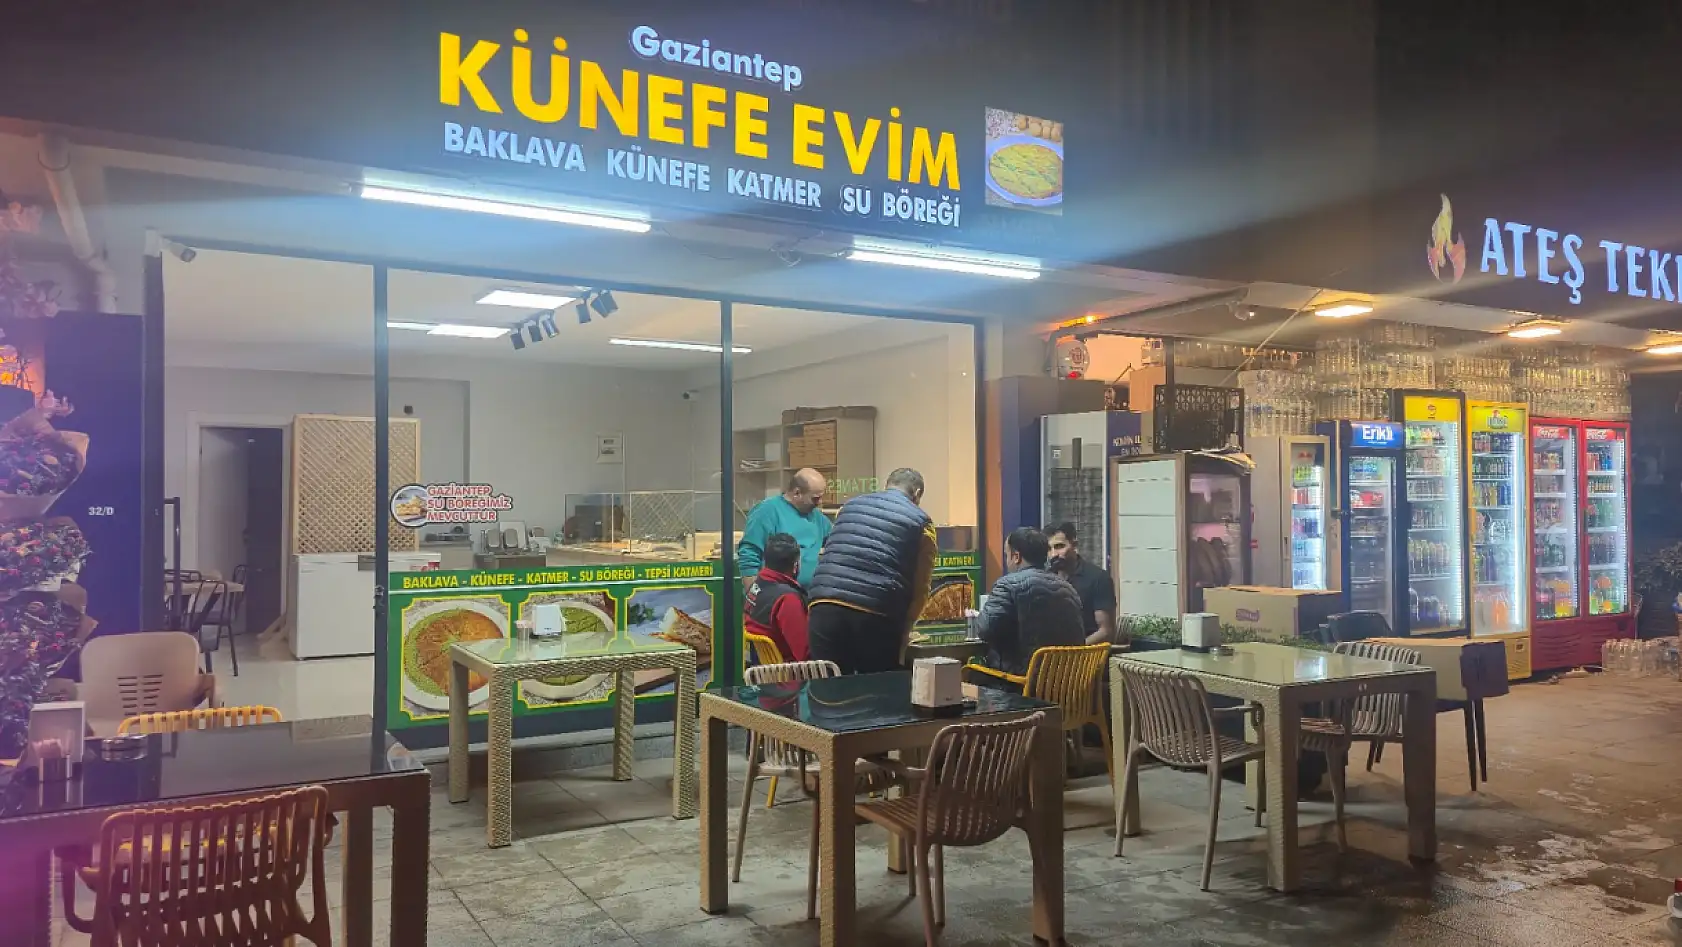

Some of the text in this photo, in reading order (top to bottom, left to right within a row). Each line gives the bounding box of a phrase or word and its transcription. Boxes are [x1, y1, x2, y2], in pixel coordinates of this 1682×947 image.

[632, 25, 802, 91] Gaziantep
[439, 28, 961, 191] KÜNEFE EVİM
[444, 121, 961, 227] BAKLAVA KÜNEFE KATMER SU BÖREĞİ
[1480, 217, 1682, 305] ATEŞ TEK
[427, 483, 491, 497] GAZİANTEP
[427, 499, 443, 509] SU
[403, 563, 714, 588] BAKLAVA KÜNEFE KATMER SU BÖREĞİ TEPSİ KATMERİ
